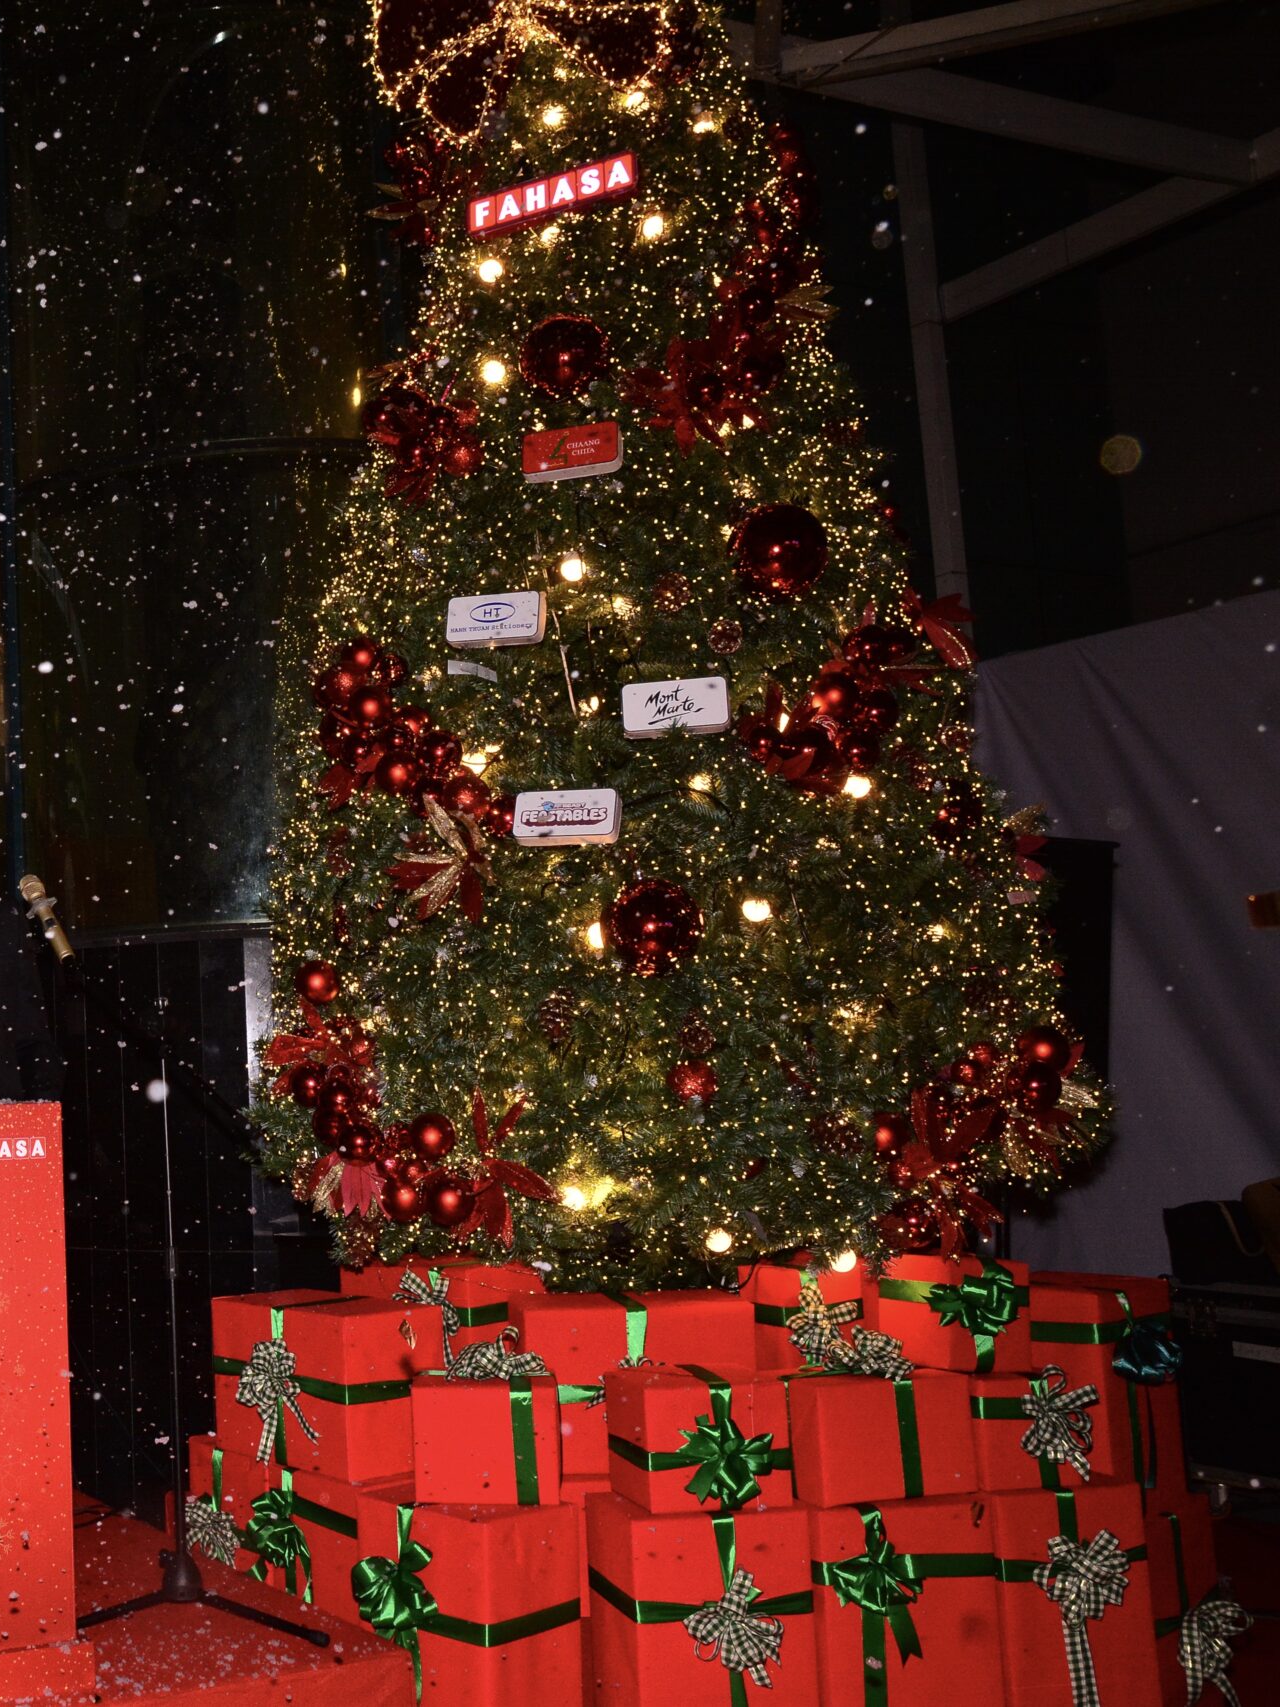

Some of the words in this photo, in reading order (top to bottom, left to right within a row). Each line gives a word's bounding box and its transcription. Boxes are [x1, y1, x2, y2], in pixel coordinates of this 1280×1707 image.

[474, 159, 631, 228] FAHASA
[566, 438, 601, 450] CHAANG
[483, 607, 502, 618] HT
[644, 684, 684, 708] Mont
[652, 696, 695, 719] Marte
[521, 807, 608, 824] FEASTABLES
